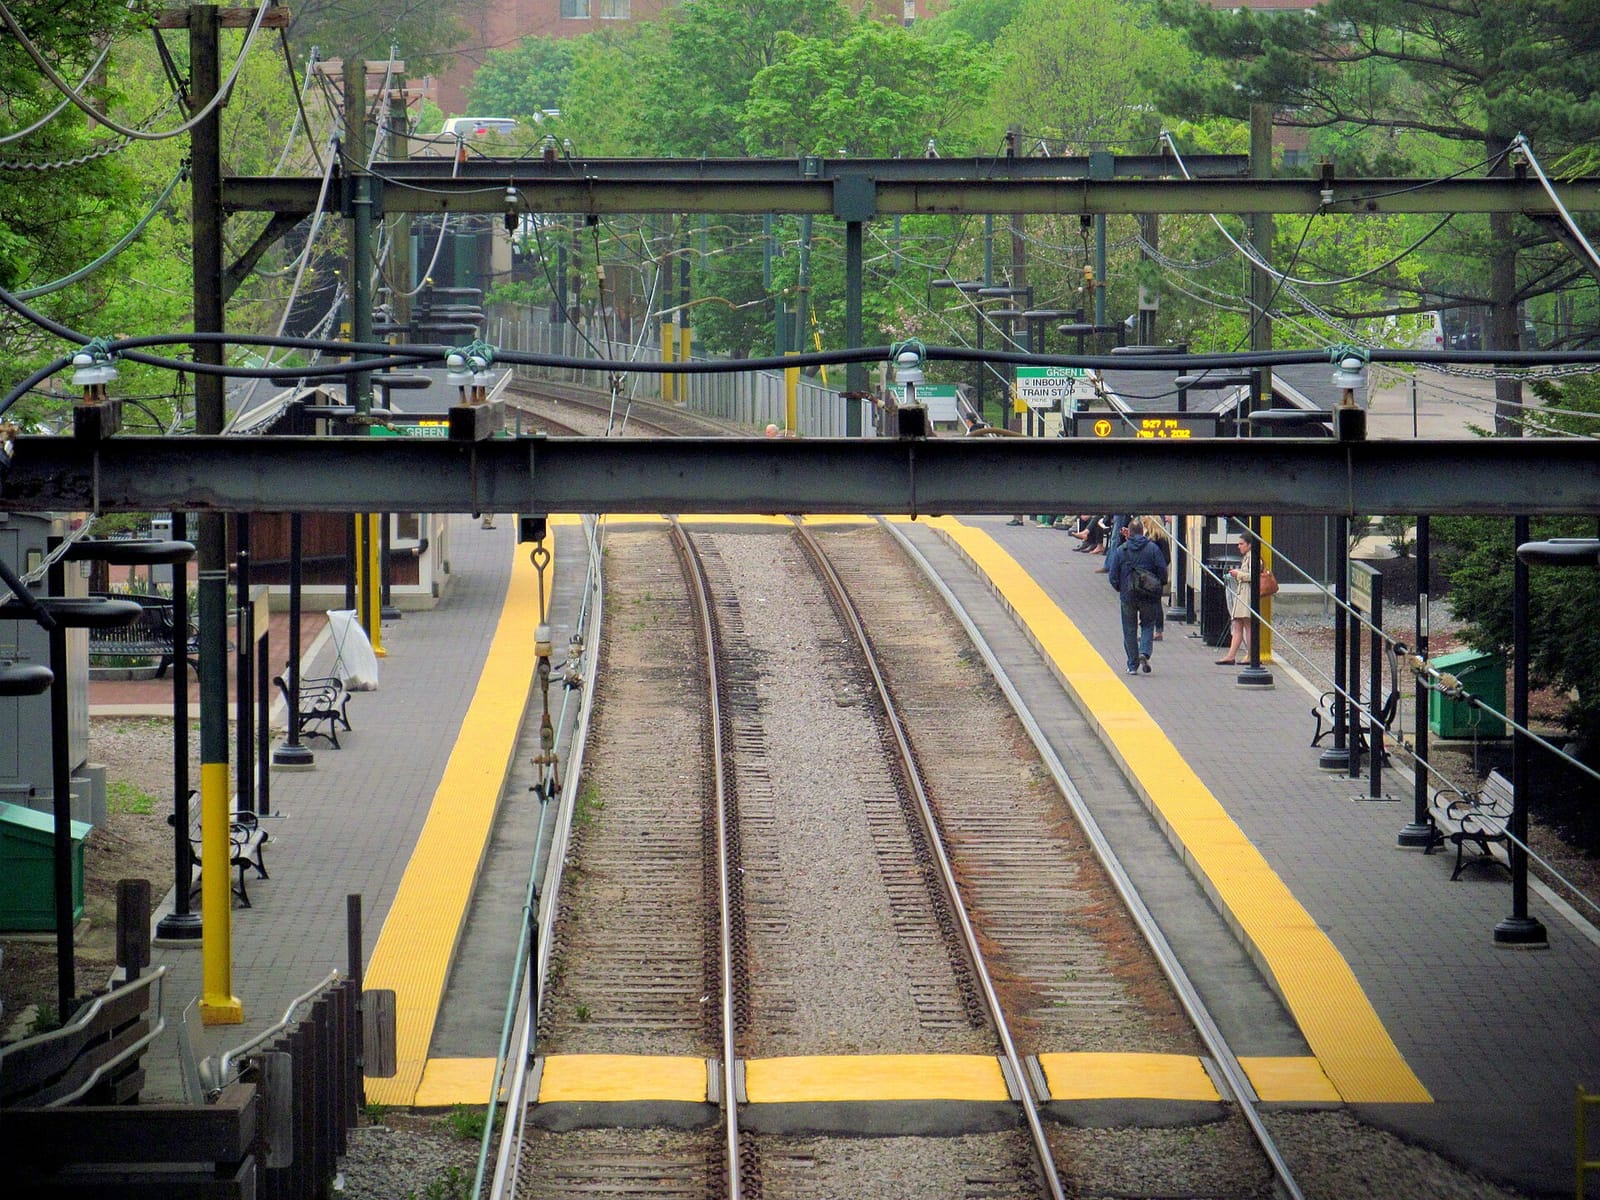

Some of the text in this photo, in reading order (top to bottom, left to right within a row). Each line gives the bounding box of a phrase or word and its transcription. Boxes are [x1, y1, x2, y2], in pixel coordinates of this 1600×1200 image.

[1022, 388, 1076, 396] TRAIN STOP
[1164, 419, 1178, 428] PM
[406, 427, 445, 437] GREEN
